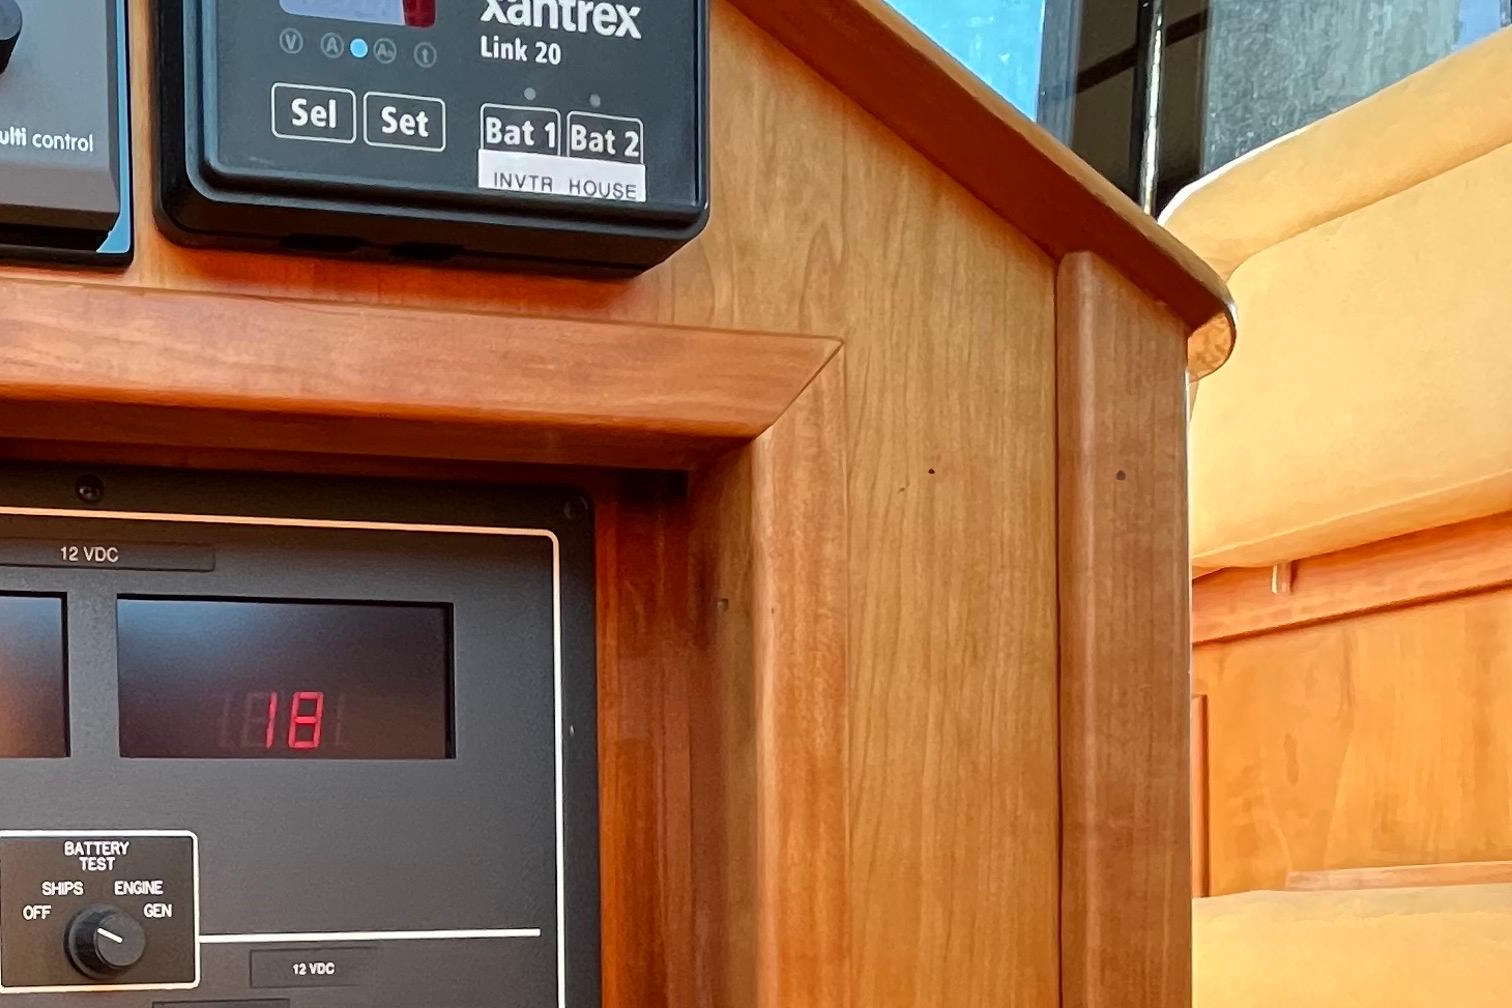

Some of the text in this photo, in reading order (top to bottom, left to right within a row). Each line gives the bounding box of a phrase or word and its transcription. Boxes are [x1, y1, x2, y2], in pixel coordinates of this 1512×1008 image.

[480, 0, 642, 39] xantrex
[481, 35, 562, 65] Link 20
[291, 98, 337, 129] Sel
[381, 106, 429, 138] Set
[32, 129, 94, 153] control
[486, 117, 555, 148] Bat 1
[571, 124, 639, 157] Bat 2
[494, 172, 637, 200] INVTR HOUSE
[60, 546, 119, 562] 12 VDC
[266, 691, 324, 749] 18
[63, 841, 129, 856] BATTERY
[79, 856, 115, 871] TEST
[42, 881, 84, 896] SHIPS
[114, 880, 164, 895] ENGINE
[23, 905, 51, 920] OFF
[144, 903, 172, 918] GEN
[293, 962, 336, 975] 12 VDC
